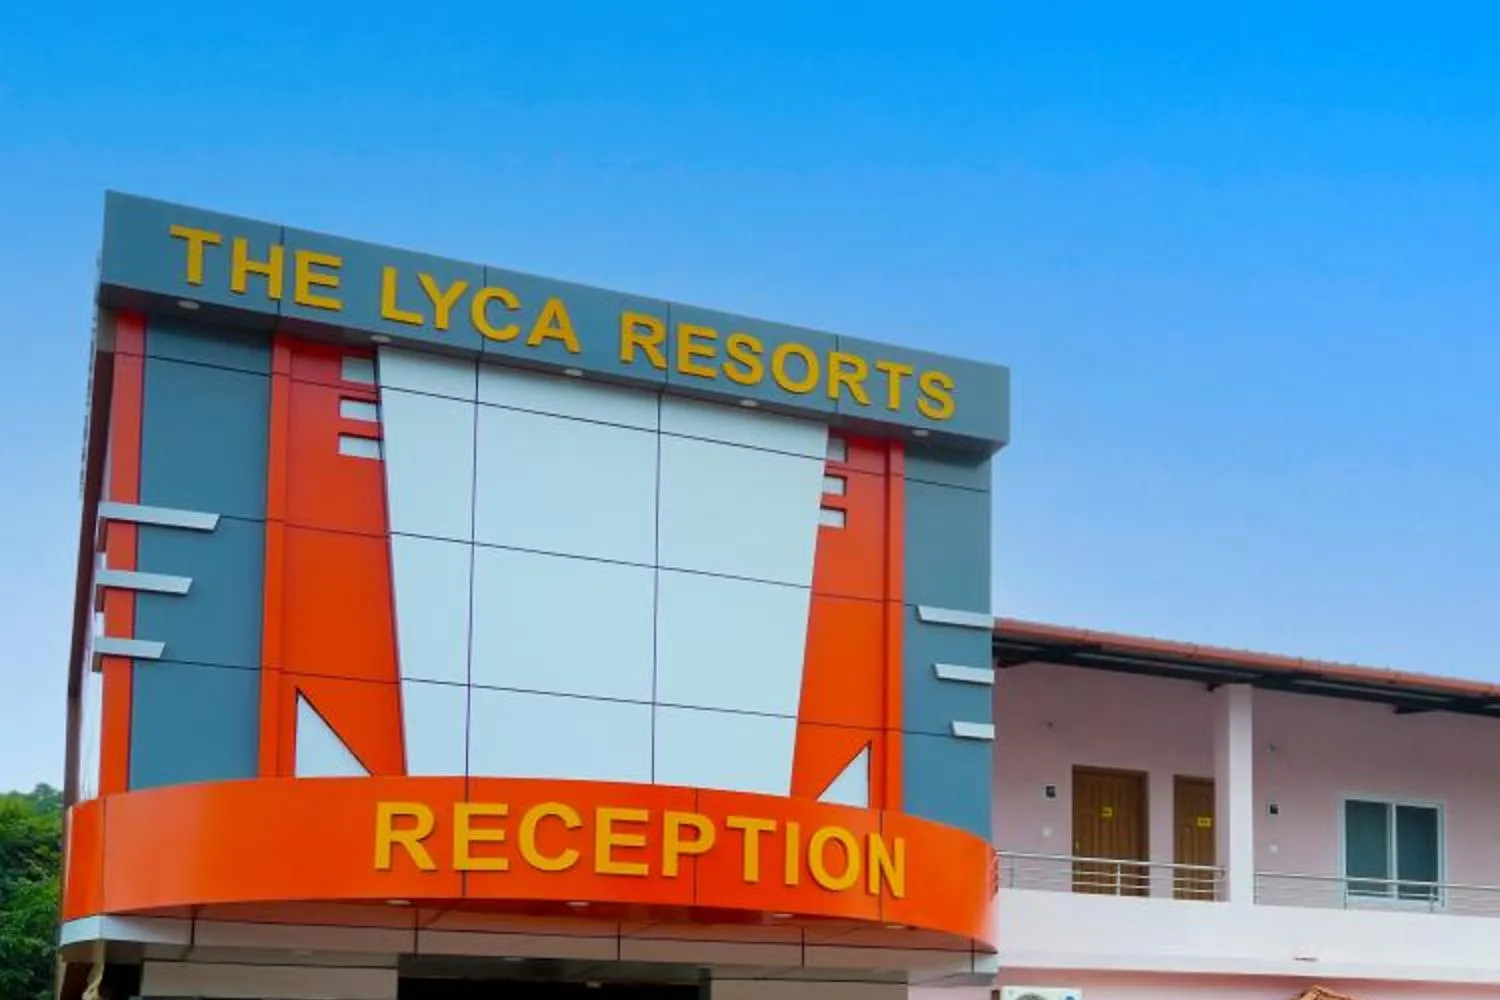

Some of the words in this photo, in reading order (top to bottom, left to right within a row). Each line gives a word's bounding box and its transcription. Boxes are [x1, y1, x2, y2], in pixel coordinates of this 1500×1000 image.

[170, 225, 343, 311] THE
[380, 267, 580, 354] LYCA
[619, 311, 957, 421] RESORTS
[374, 801, 906, 898] RECEPTION
